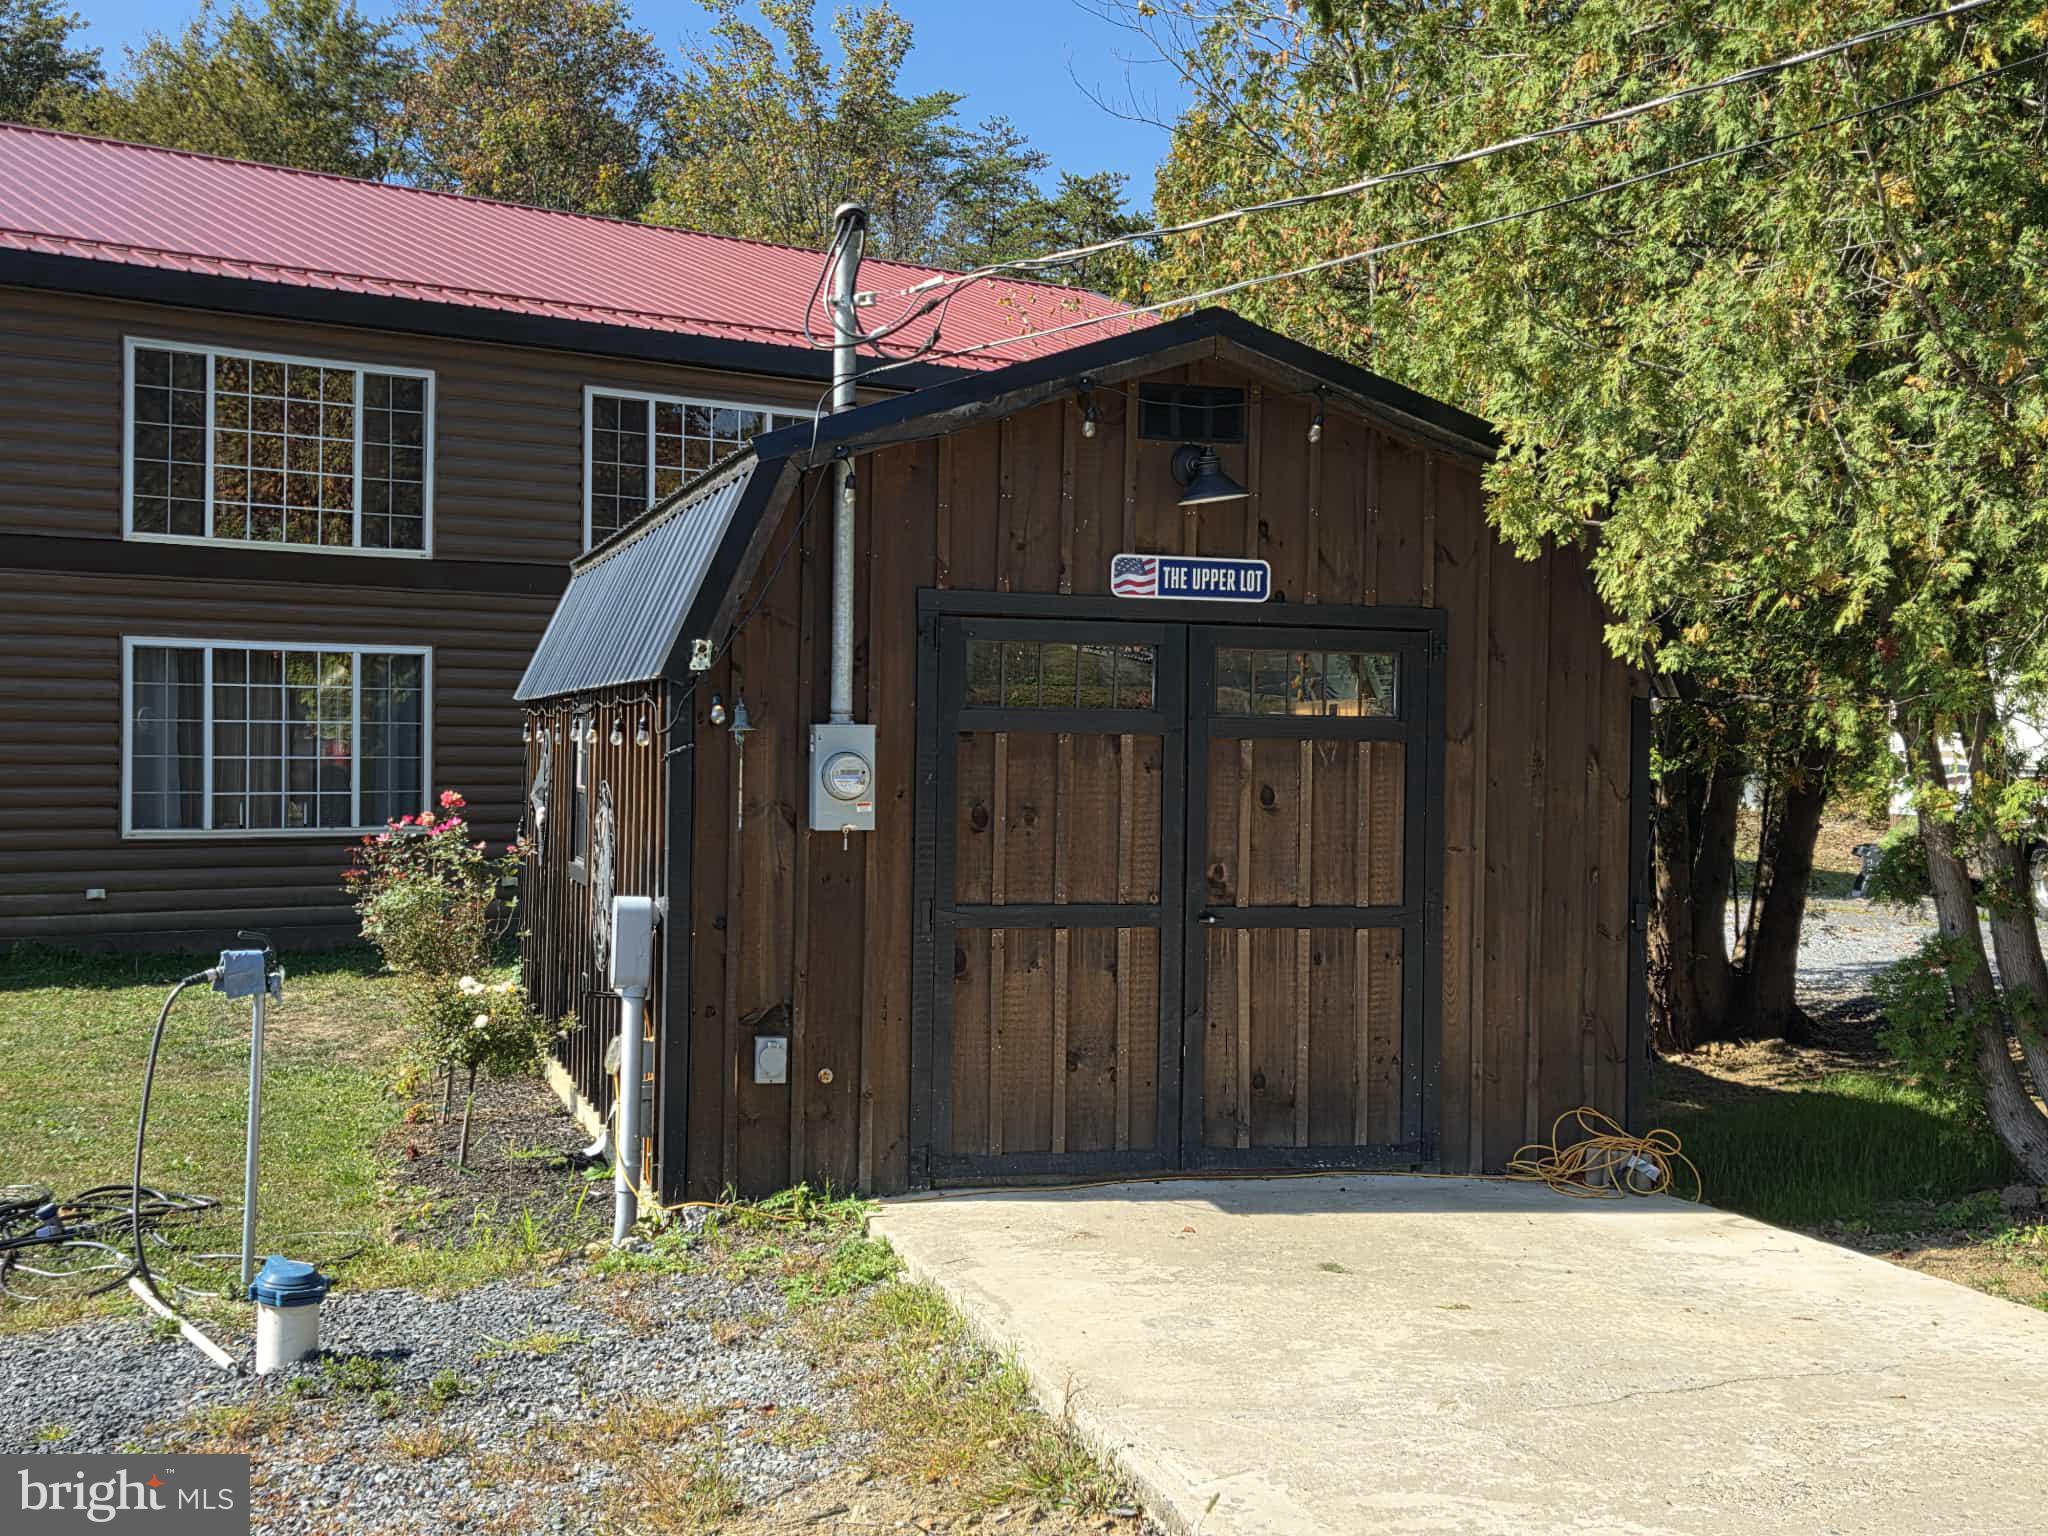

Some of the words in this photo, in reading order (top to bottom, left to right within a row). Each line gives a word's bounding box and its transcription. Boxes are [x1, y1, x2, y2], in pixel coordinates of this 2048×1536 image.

[1163, 567, 1188, 589] THE
[1192, 569, 1235, 591] UPPER
[1240, 570, 1263, 592] LOT
